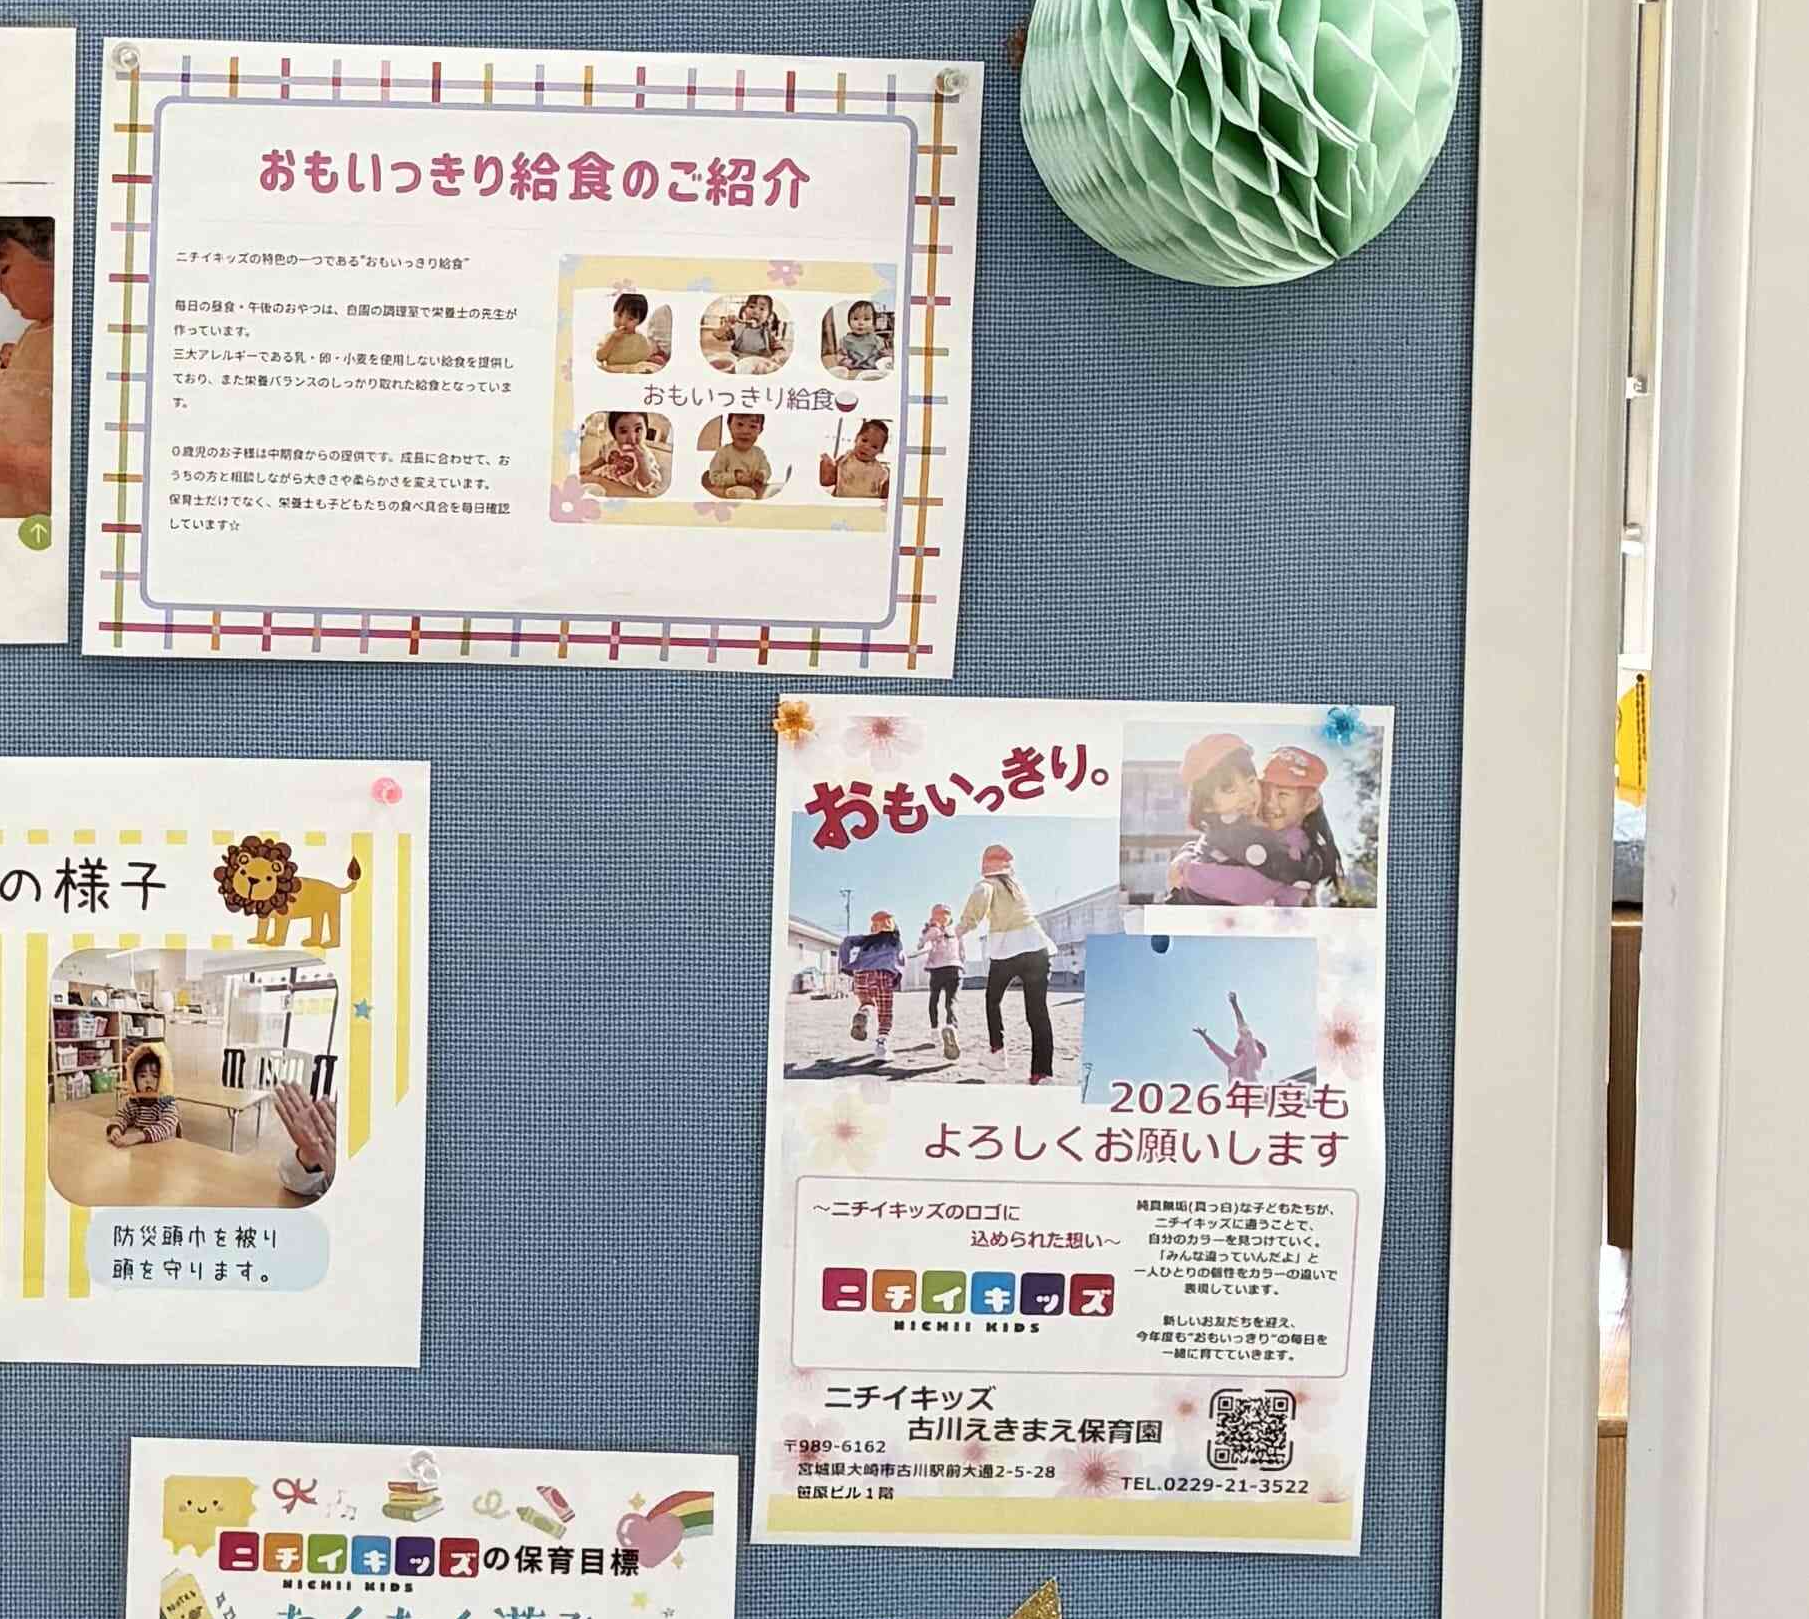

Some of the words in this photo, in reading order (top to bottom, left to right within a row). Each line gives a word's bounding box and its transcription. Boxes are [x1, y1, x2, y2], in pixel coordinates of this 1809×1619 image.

[259, 148, 811, 209] おもいっきり給食のご紹介
[173, 323, 250, 338] 作っています。
[172, 397, 188, 409] す。
[643, 383, 835, 412] おもいっきり給食
[805, 743, 1109, 851] おもいっきり。
[1110, 1080, 1349, 1120] 2026年度も
[924, 1122, 1350, 1168] よろしくお願いします
[113, 1224, 277, 1249] 防災頭巾を被り
[1148, 1232, 1320, 1249] 自分のカラーを見つけていく。
[111, 1257, 269, 1283] 頭を守ります。
[828, 1276, 1114, 1315] ニチイキッズ
[1184, 1282, 1279, 1296] 表現しています。
[894, 1321, 972, 1333] NICHII
[987, 1322, 1040, 1334] KIDS
[824, 1385, 997, 1412] ニチイキッズ
[907, 1415, 1163, 1445] 古川えきまえ保育園
[783, 1439, 886, 1454] 〒989-6162
[1120, 1476, 1309, 1495] TEL.0229-21-3522
[283, 1580, 352, 1591] NICHII
[365, 1582, 414, 1593] KIDS
